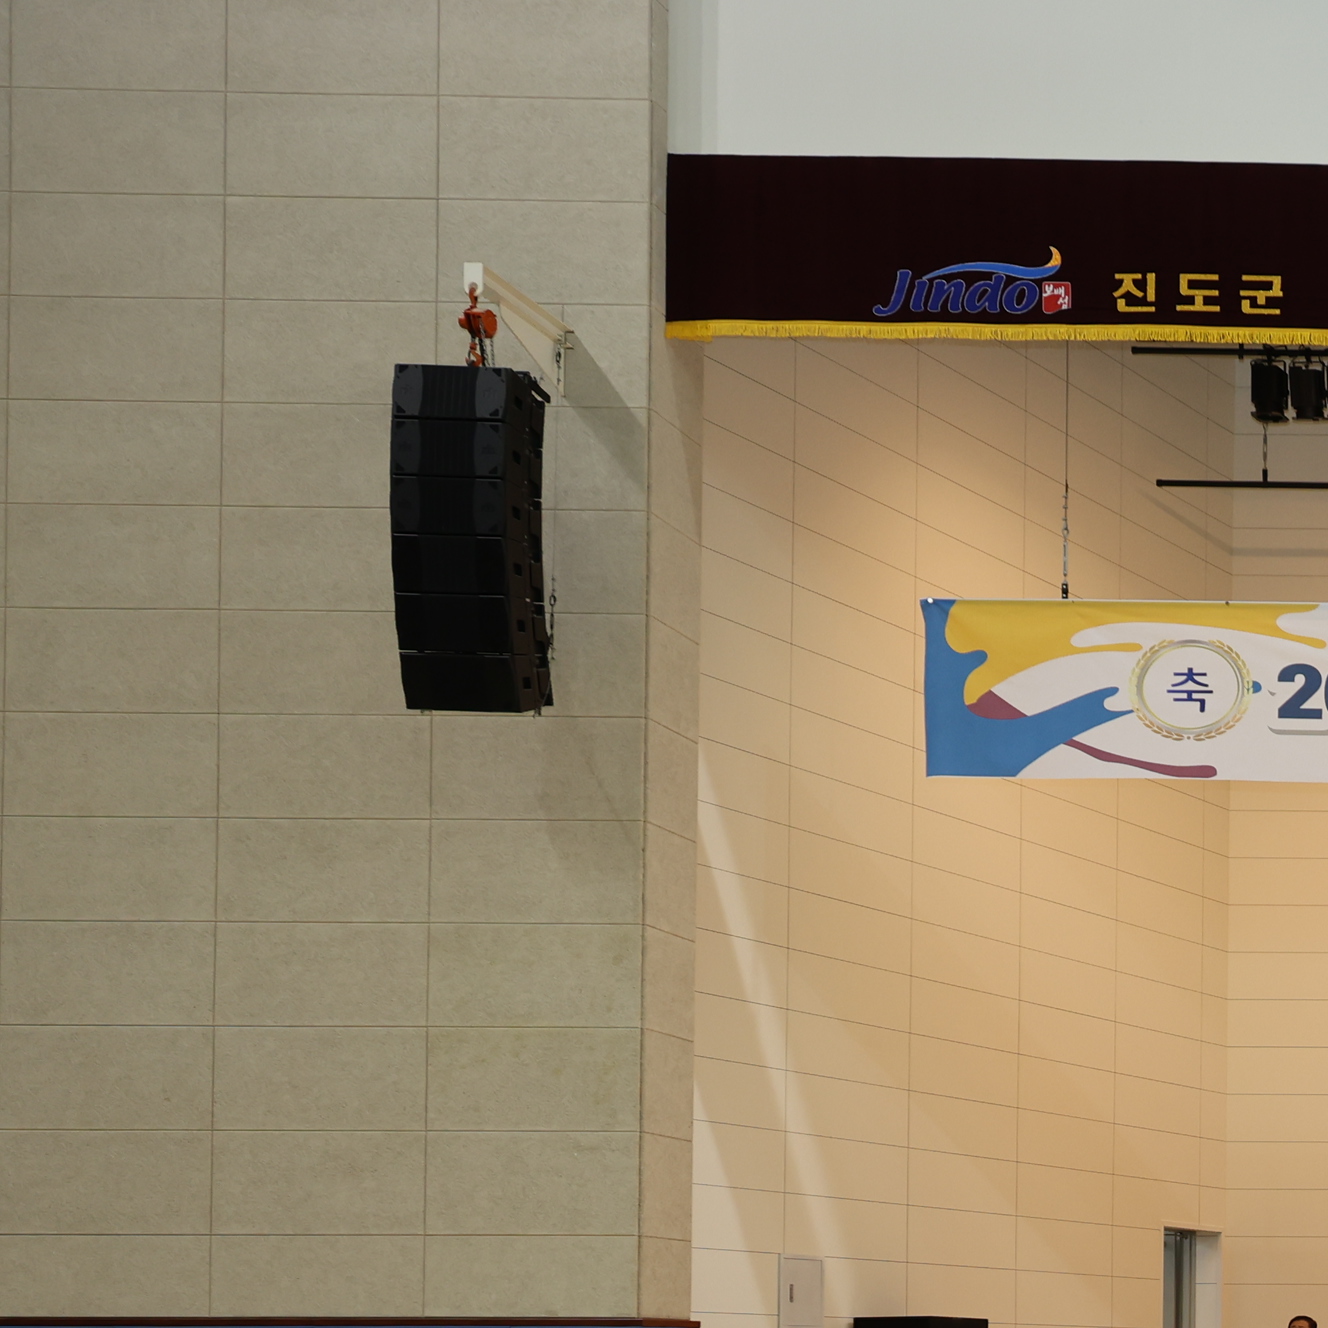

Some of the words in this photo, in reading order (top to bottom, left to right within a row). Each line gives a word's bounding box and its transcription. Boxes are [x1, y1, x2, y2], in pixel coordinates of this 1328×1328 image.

[873, 269, 1039, 316] Jindo
[1113, 271, 1283, 314] 진도군
[1166, 666, 1213, 714] 축
